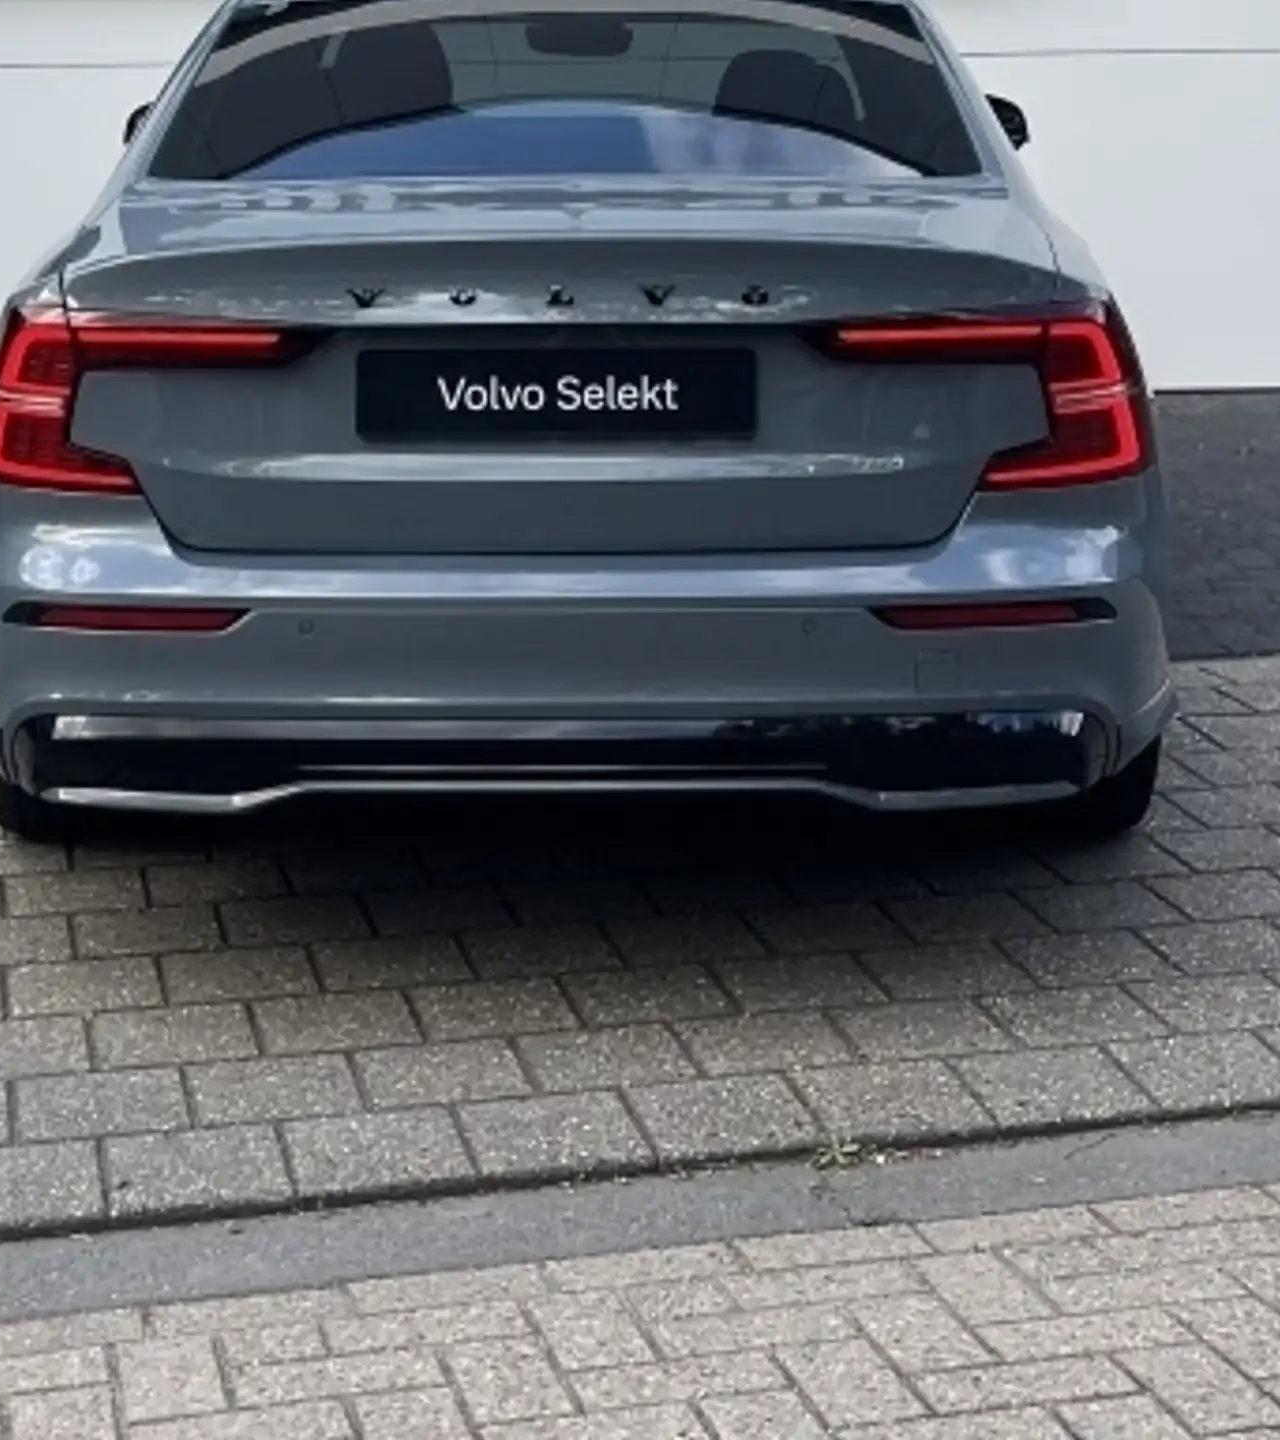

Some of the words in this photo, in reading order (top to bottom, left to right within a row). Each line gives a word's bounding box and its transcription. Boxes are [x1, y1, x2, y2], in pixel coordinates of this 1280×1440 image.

[347, 282, 771, 309] VOLVO
[437, 375, 546, 411] Volvo
[556, 375, 680, 412] Selekt
